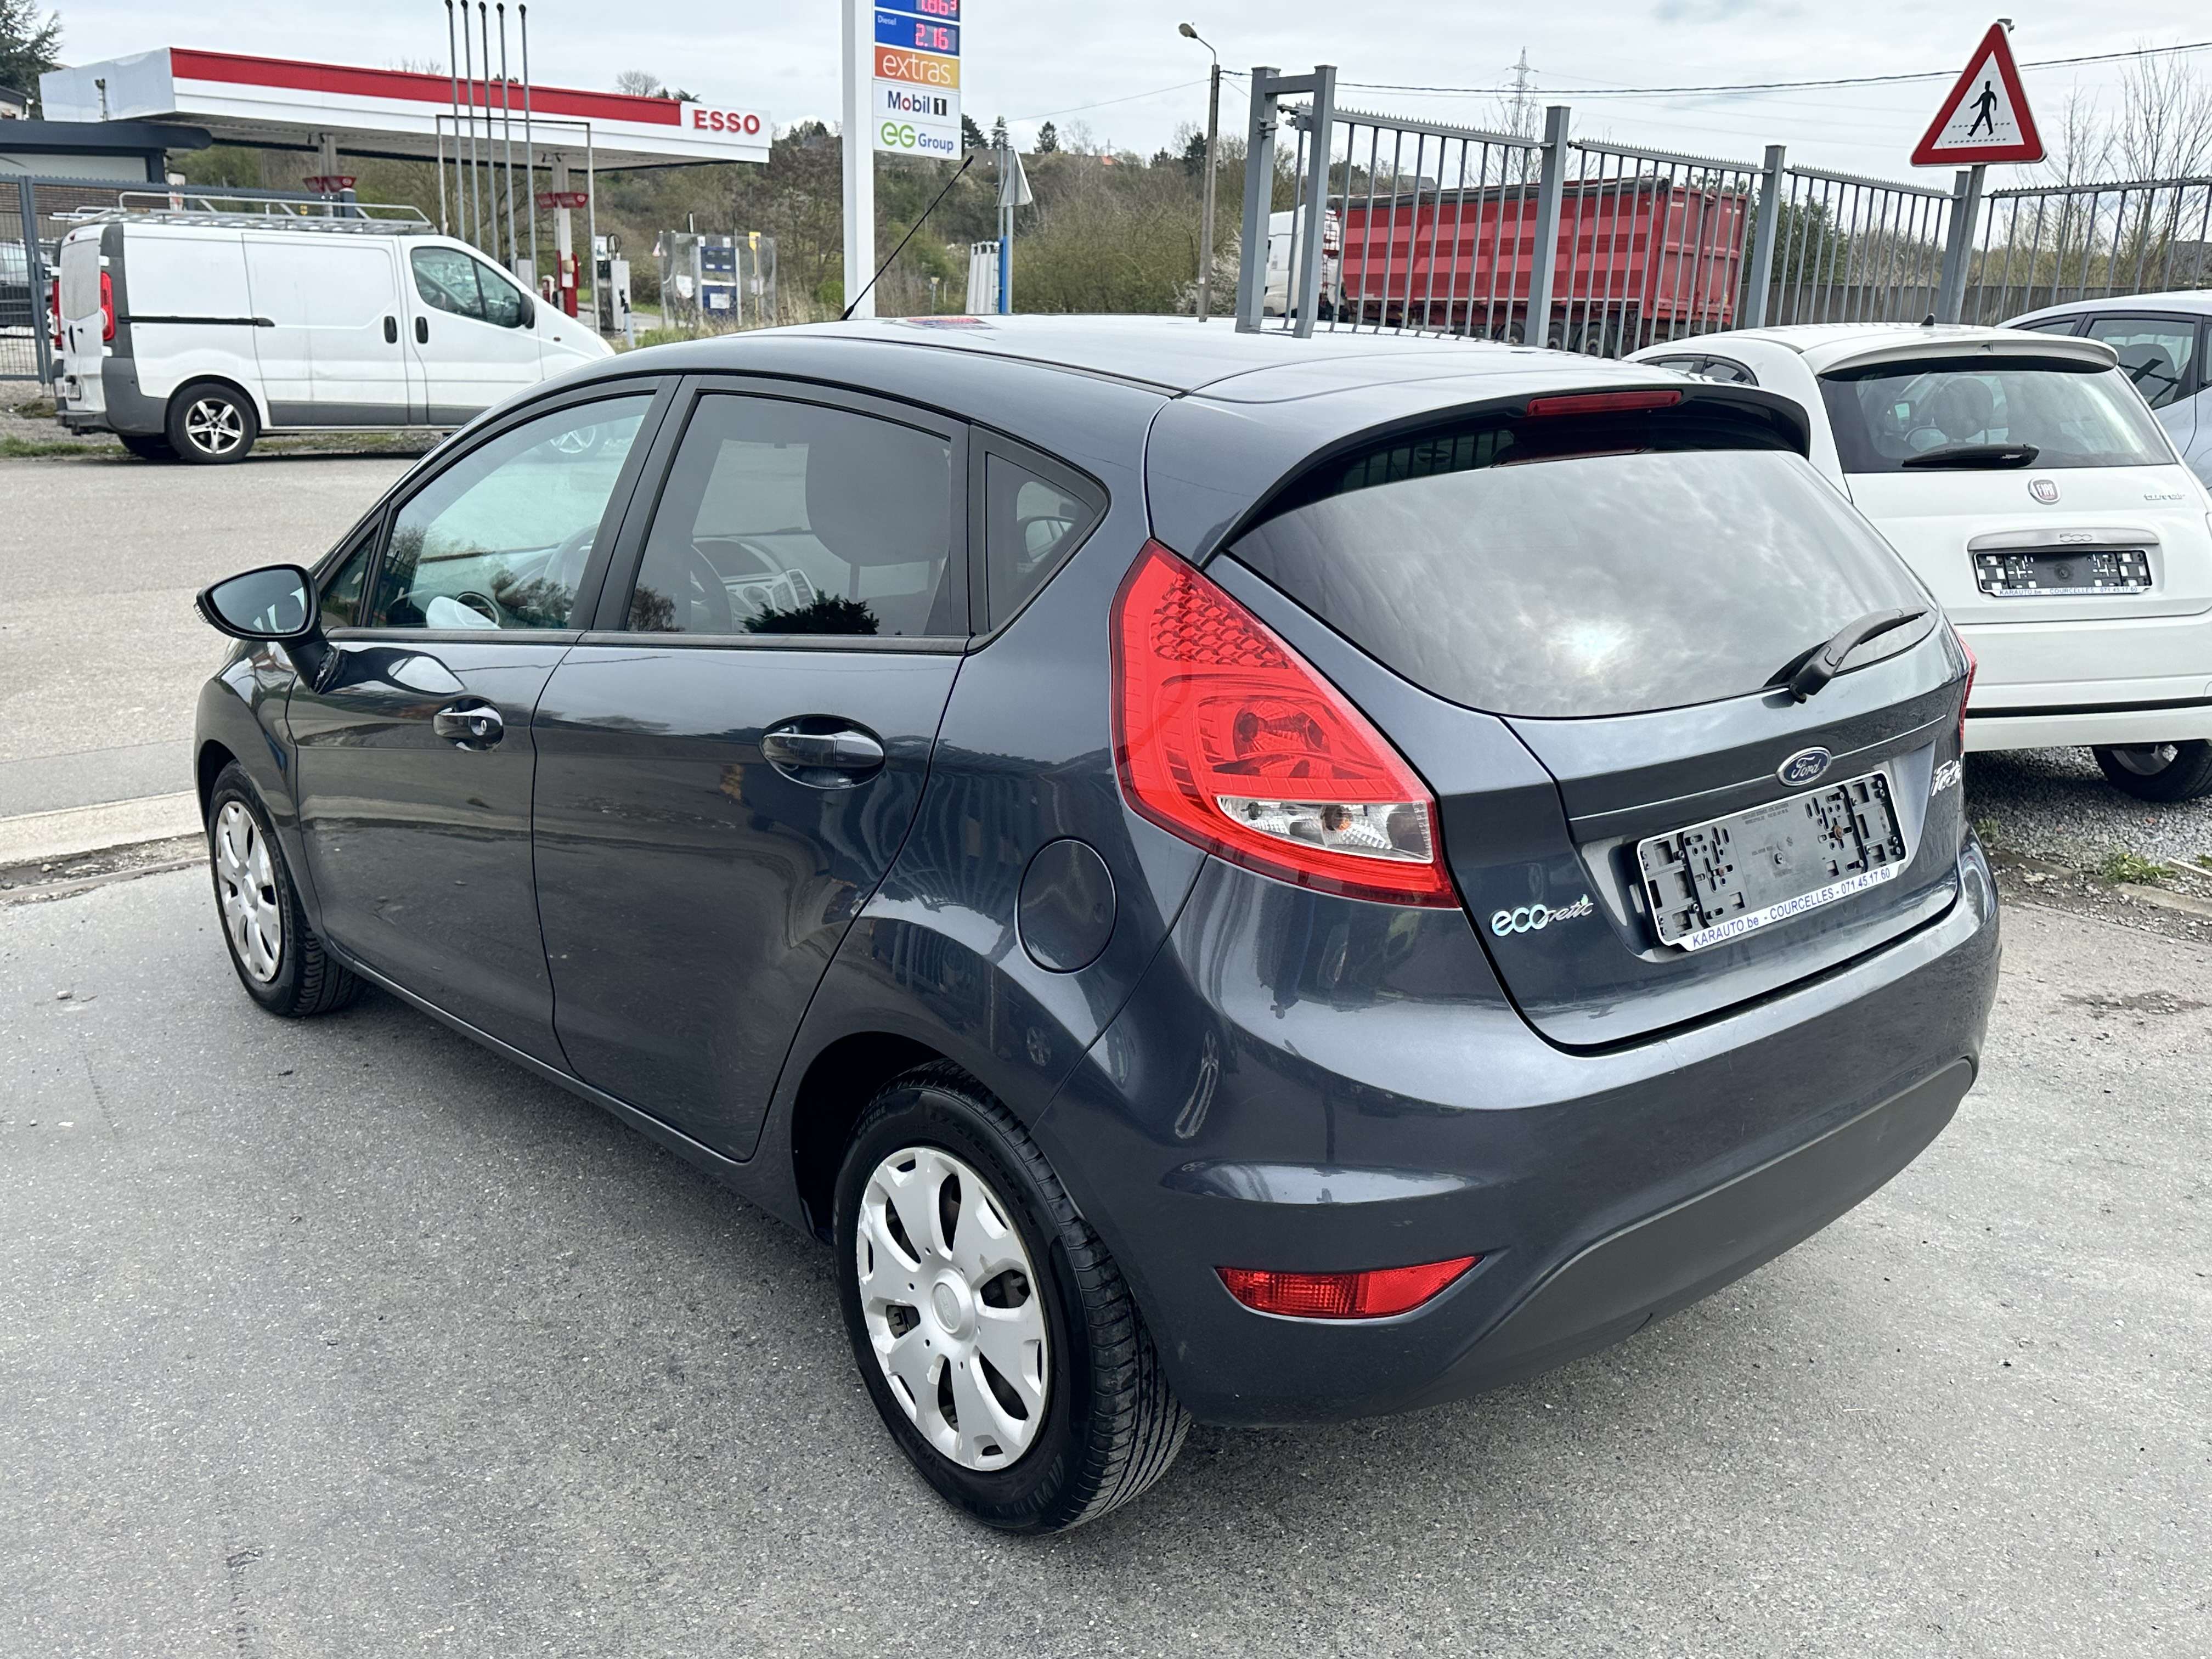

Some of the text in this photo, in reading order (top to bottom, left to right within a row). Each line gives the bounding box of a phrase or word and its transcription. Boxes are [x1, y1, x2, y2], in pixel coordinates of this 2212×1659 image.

[878, 15, 896, 25] Diesel
[883, 54, 951, 84] extras
[888, 91, 945, 116] Mobil 1
[693, 110, 760, 134] ESSO
[918, 133, 953, 154] Group
[2036, 483, 2055, 496] FIAT
[2059, 533, 2093, 543] 500
[1791, 755, 1821, 779] Ford
[1692, 917, 1759, 948] KARAUTO.be
[1770, 888, 1834, 919] COURCELLES
